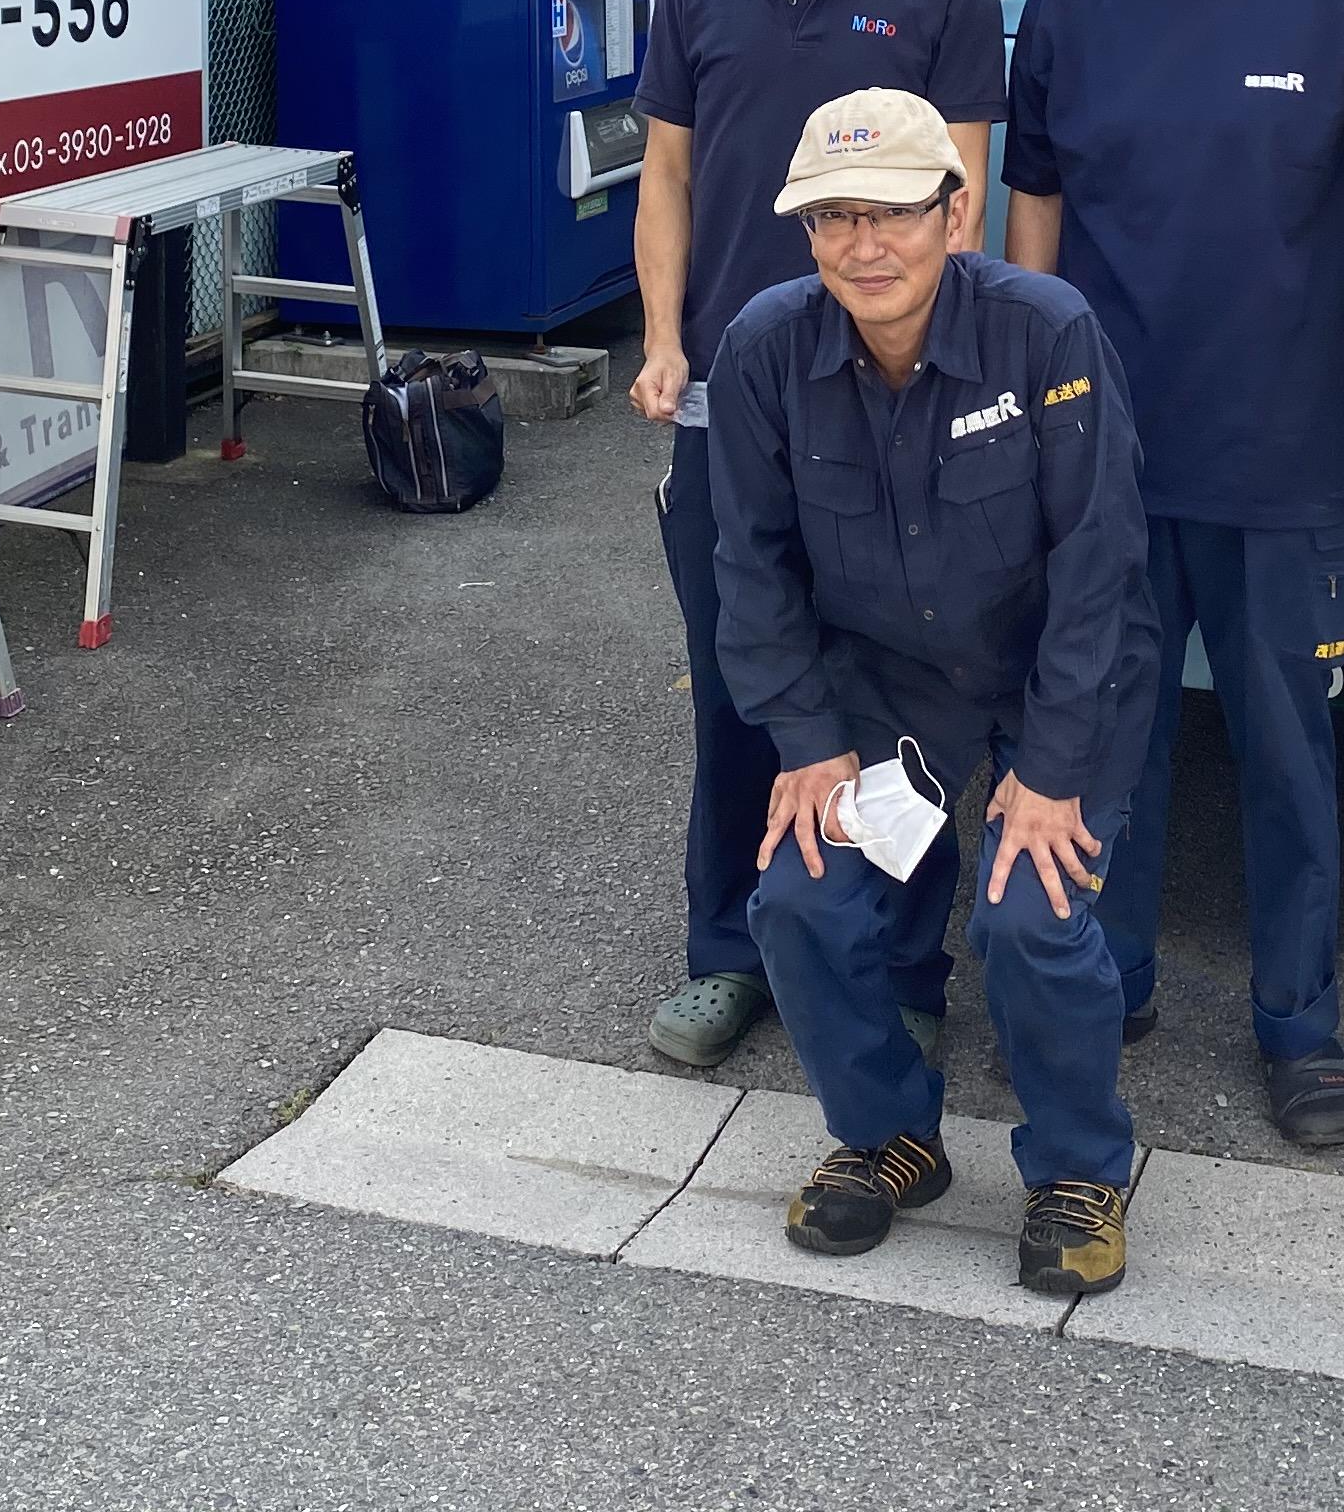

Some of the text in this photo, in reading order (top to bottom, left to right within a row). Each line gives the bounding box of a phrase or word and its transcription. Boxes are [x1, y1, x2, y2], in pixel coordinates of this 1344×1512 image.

[852, 15, 897, 37] MoRo
[566, 65, 589, 88] pepsi
[827, 128, 881, 146] MoRo
